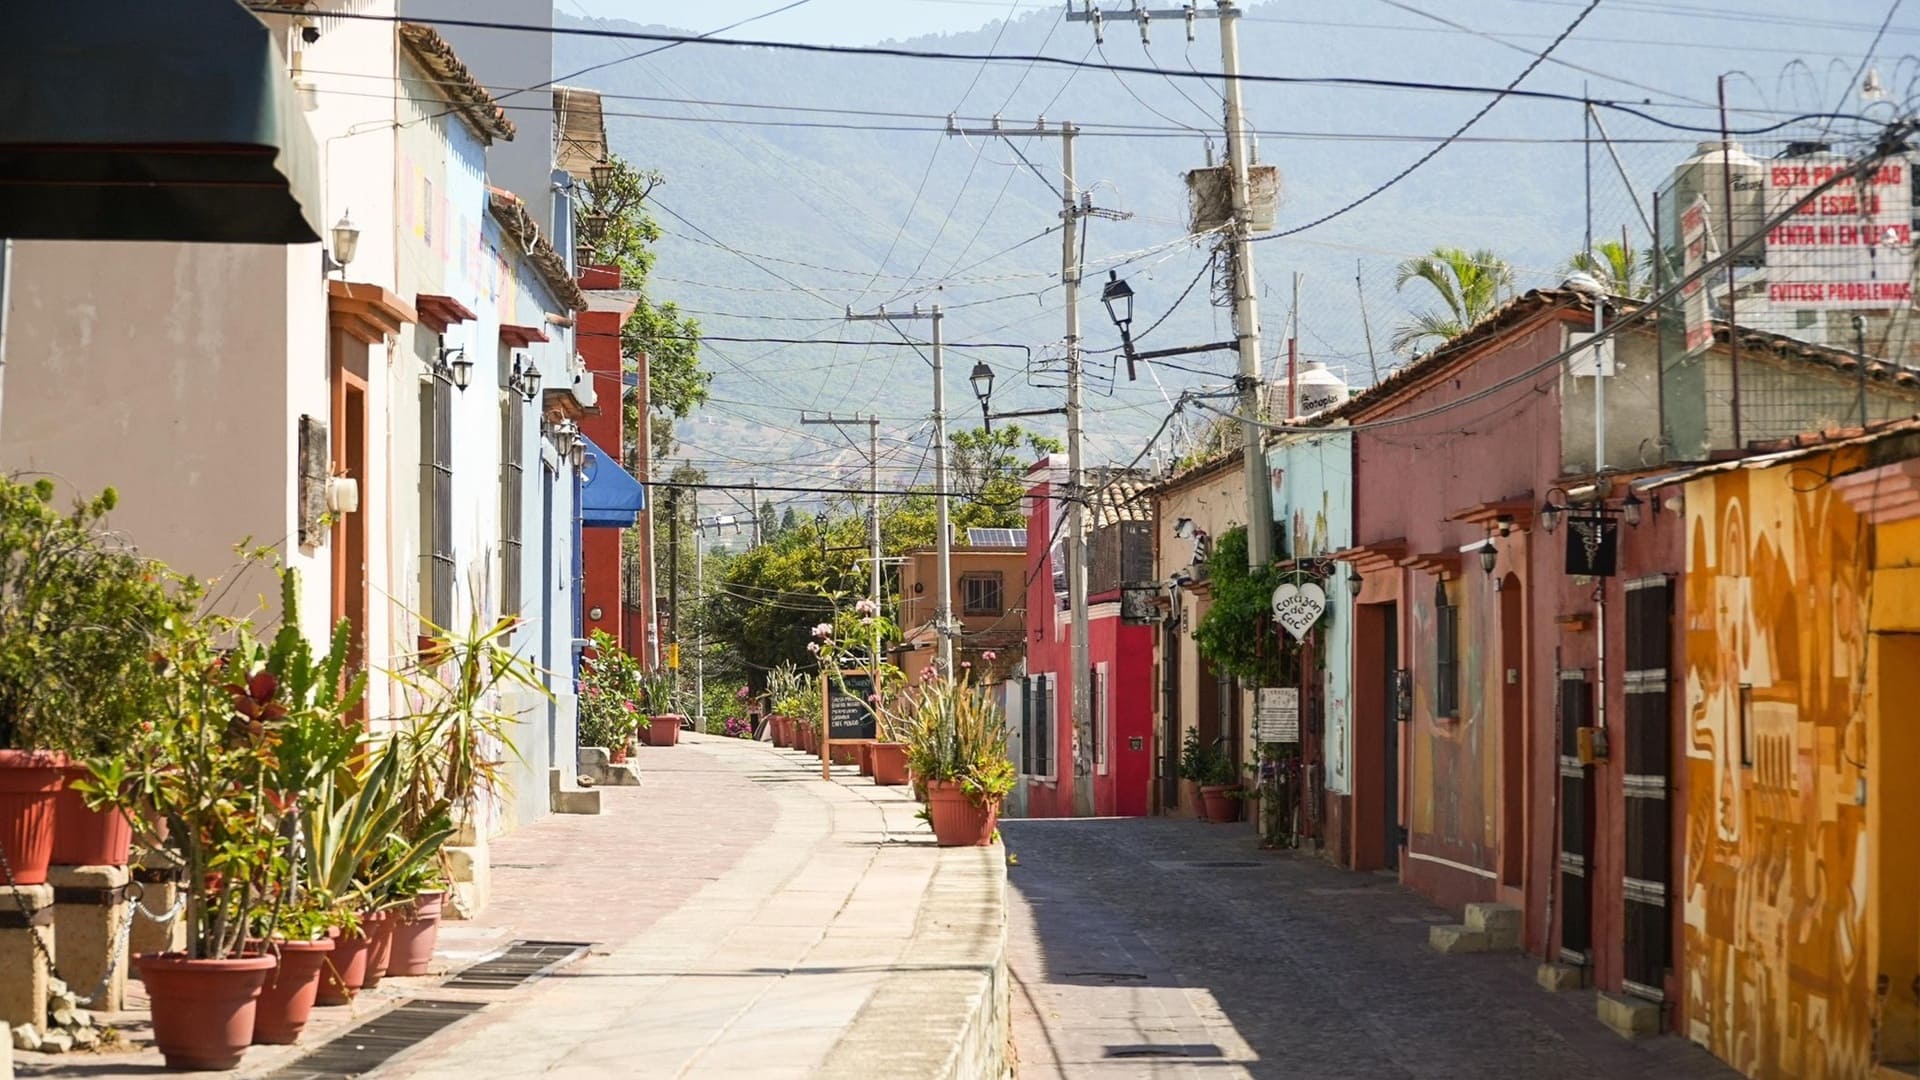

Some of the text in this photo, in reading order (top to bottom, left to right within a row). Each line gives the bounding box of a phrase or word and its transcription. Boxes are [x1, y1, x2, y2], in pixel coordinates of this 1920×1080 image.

[1771, 167, 1809, 187] ESTA
[1813, 165, 1902, 186] PROAD
[1821, 196, 1857, 216] ESTA
[1768, 225, 1814, 245] VENTA
[1820, 226, 1834, 245] NI
[1840, 226, 1858, 245] EN
[1771, 282, 1912, 301] EVITESE PROBLEMAS
[1290, 605, 1304, 614] de
